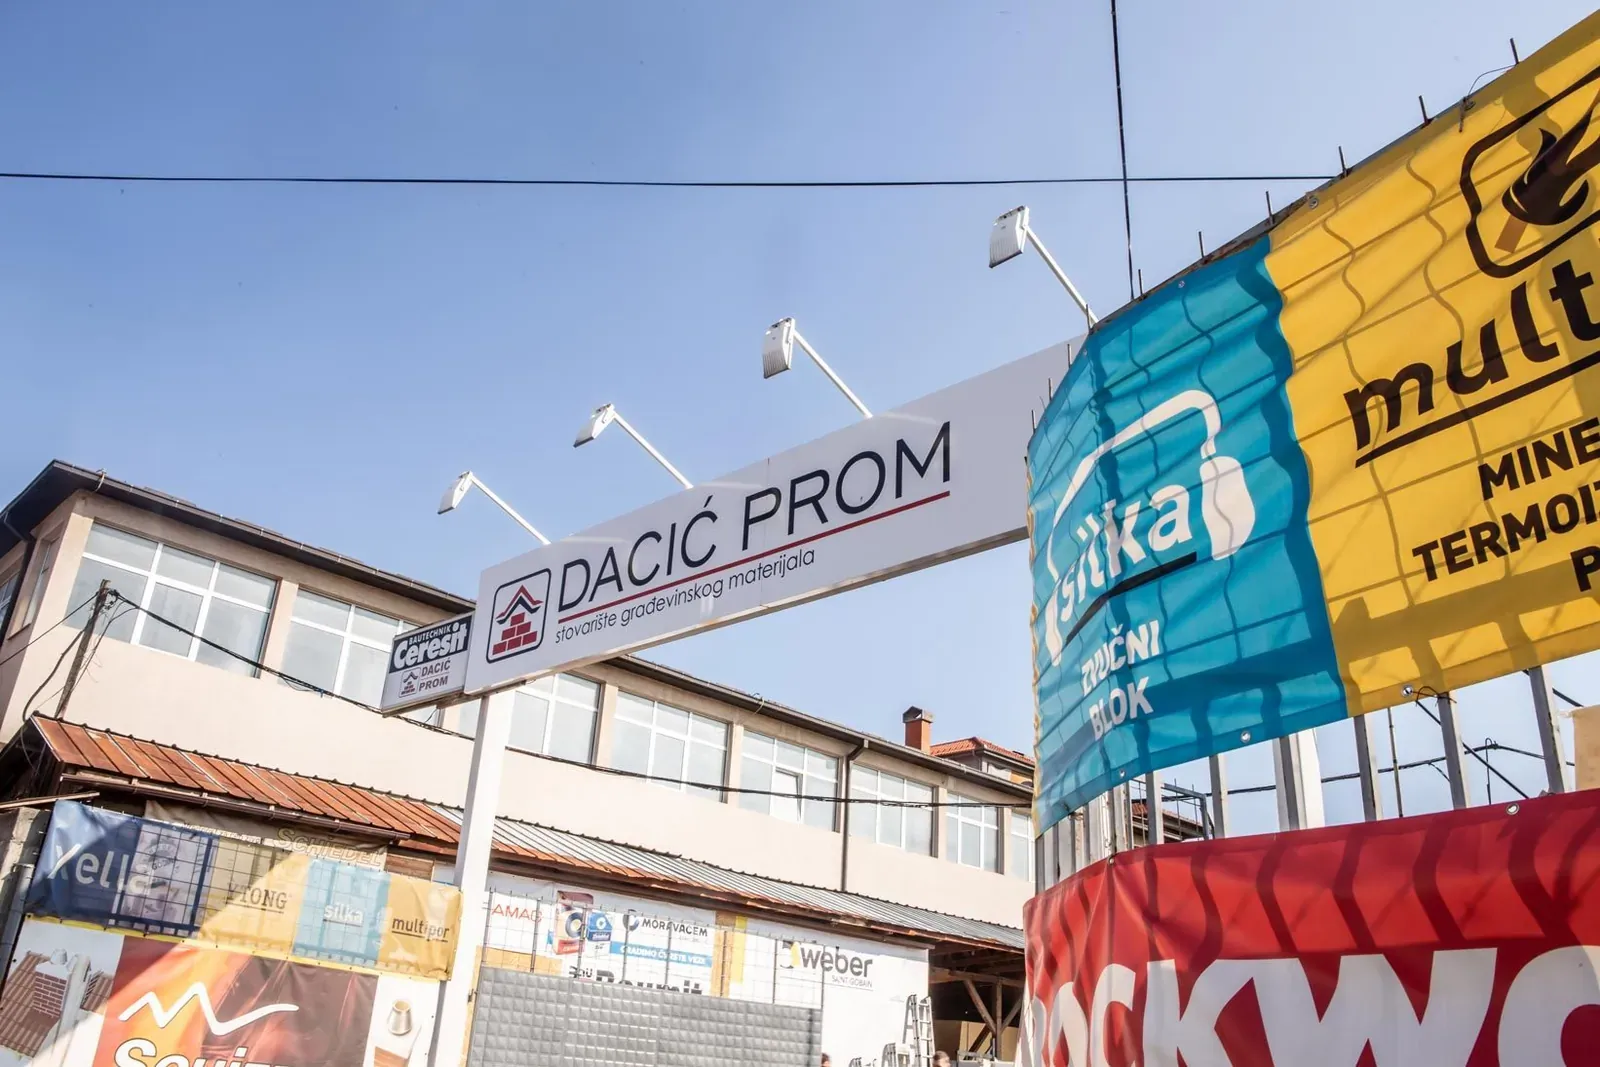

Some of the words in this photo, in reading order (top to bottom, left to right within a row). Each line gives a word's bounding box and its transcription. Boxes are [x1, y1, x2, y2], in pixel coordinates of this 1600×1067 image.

[558, 495, 719, 613] DACIĆ
[741, 421, 951, 551] PROM
[1061, 485, 1193, 622] silka
[555, 613, 617, 643] stovarište
[620, 578, 724, 627] građevinskog
[728, 548, 815, 590] materijala
[393, 622, 467, 669] Ceresit
[408, 625, 452, 645] BAUTECHNIK
[421, 657, 451, 677] DACIĆ
[1081, 619, 1160, 697] ZVUČNI
[419, 676, 448, 692] PROM
[1088, 676, 1154, 740] BLOK
[228, 881, 288, 910] YTONG
[324, 902, 364, 924] silka
[392, 917, 450, 939] multipor
[800, 946, 873, 978] weber
